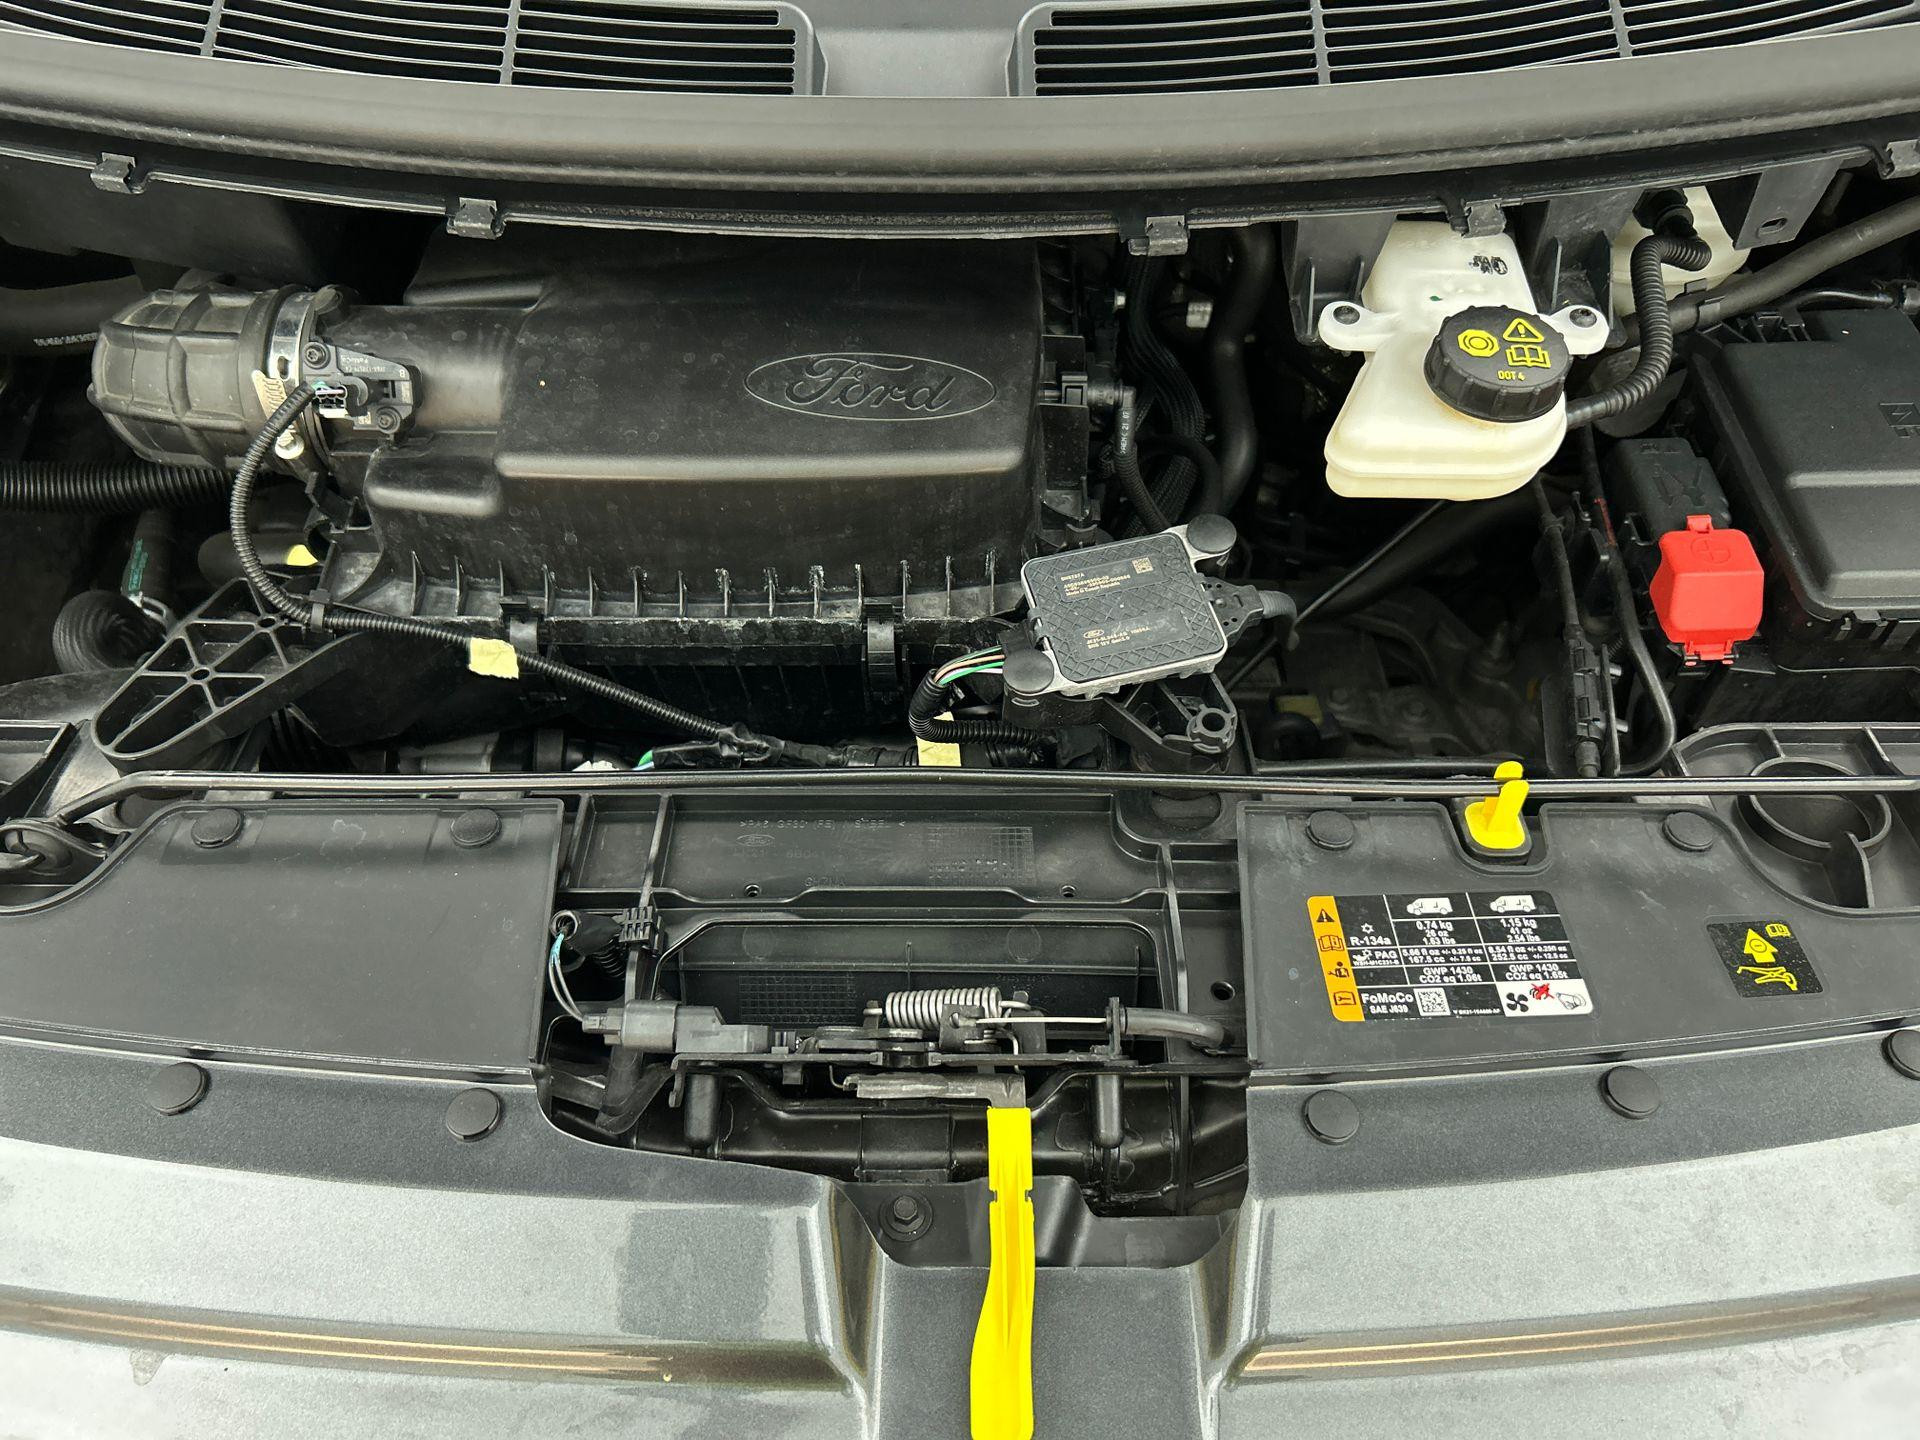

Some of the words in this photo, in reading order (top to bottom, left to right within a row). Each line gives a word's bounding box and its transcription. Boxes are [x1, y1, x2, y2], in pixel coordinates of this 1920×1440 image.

[1497, 370, 1517, 381] DOT
[1517, 372, 1525, 381] 4
[785, 358, 956, 412] Ford
[1416, 921, 1438, 930] 0.74
[1439, 920, 1454, 932] kg
[1501, 918, 1522, 927] 1.15
[1522, 917, 1538, 929] kg
[1349, 935, 1392, 946] R-134a
[1441, 937, 1456, 945] lbs
[1507, 934, 1525, 943] 2.54
[1525, 934, 1541, 942] lbs
[1374, 950, 1398, 959] PAG
[1491, 953, 1516, 961] 252.5
[1423, 967, 1448, 975] GWP
[1450, 966, 1473, 975] 1430
[1509, 964, 1534, 973] GWP
[1535, 963, 1559, 972] 1430
[1419, 975, 1442, 983] CO2
[1443, 976, 1457, 984] eq
[1505, 972, 1528, 980] CO2
[1529, 972, 1543, 981] eq
[1543, 971, 1569, 979] 1.65t
[1361, 992, 1414, 1003] FoMoCo
[1369, 1005, 1388, 1014] SAE
[1388, 1004, 1409, 1013] J639
